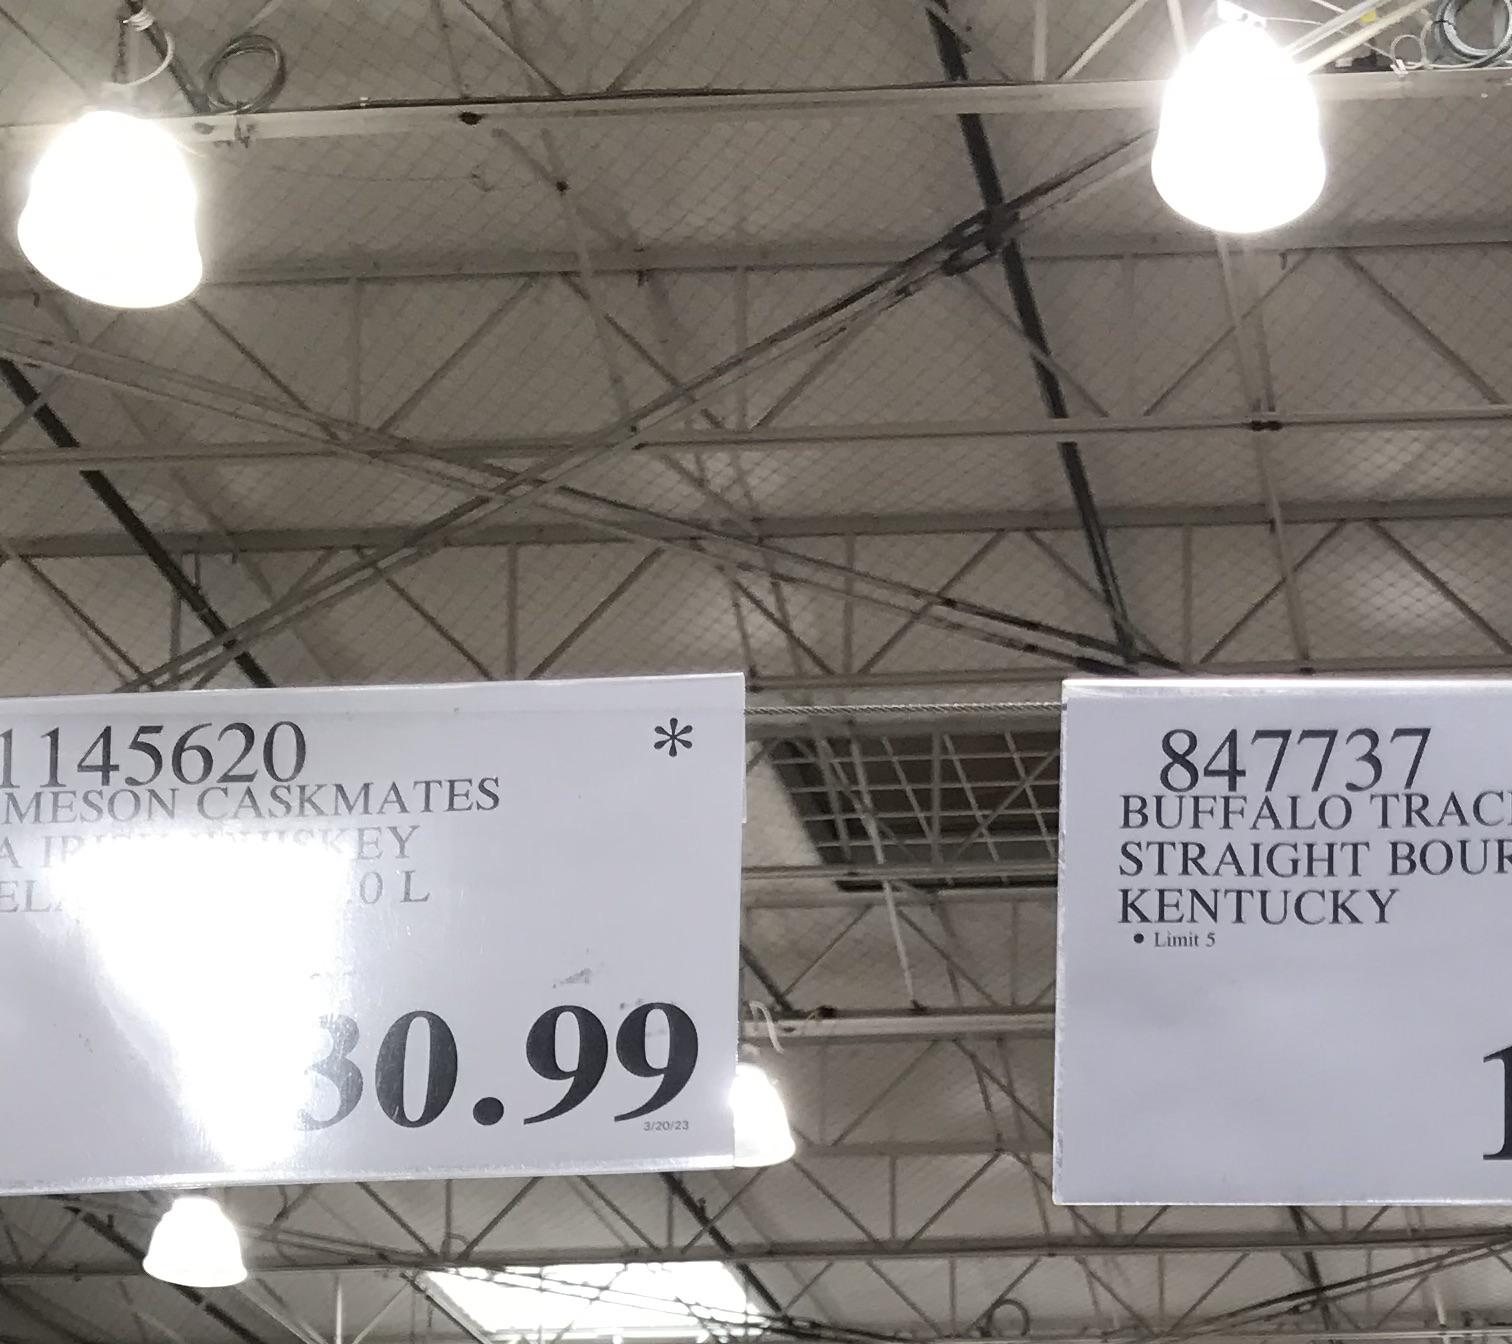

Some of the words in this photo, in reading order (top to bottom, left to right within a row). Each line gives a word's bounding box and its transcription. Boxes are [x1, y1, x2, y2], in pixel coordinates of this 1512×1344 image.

[0, 720, 306, 789] 1145620
[1159, 727, 1432, 793] 847737
[0, 787, 179, 825] MESON
[197, 777, 501, 820] CASKMATES
[1119, 794, 1354, 831] BUFFALO
[1118, 841, 1371, 878] STRAIGHT
[1117, 888, 1400, 926] KENTUCKY
[1153, 931, 1200, 949] Limit
[1205, 931, 1216, 949] 5
[298, 1002, 699, 1131] 30.99
[644, 1121, 690, 1132] 3/20/23
